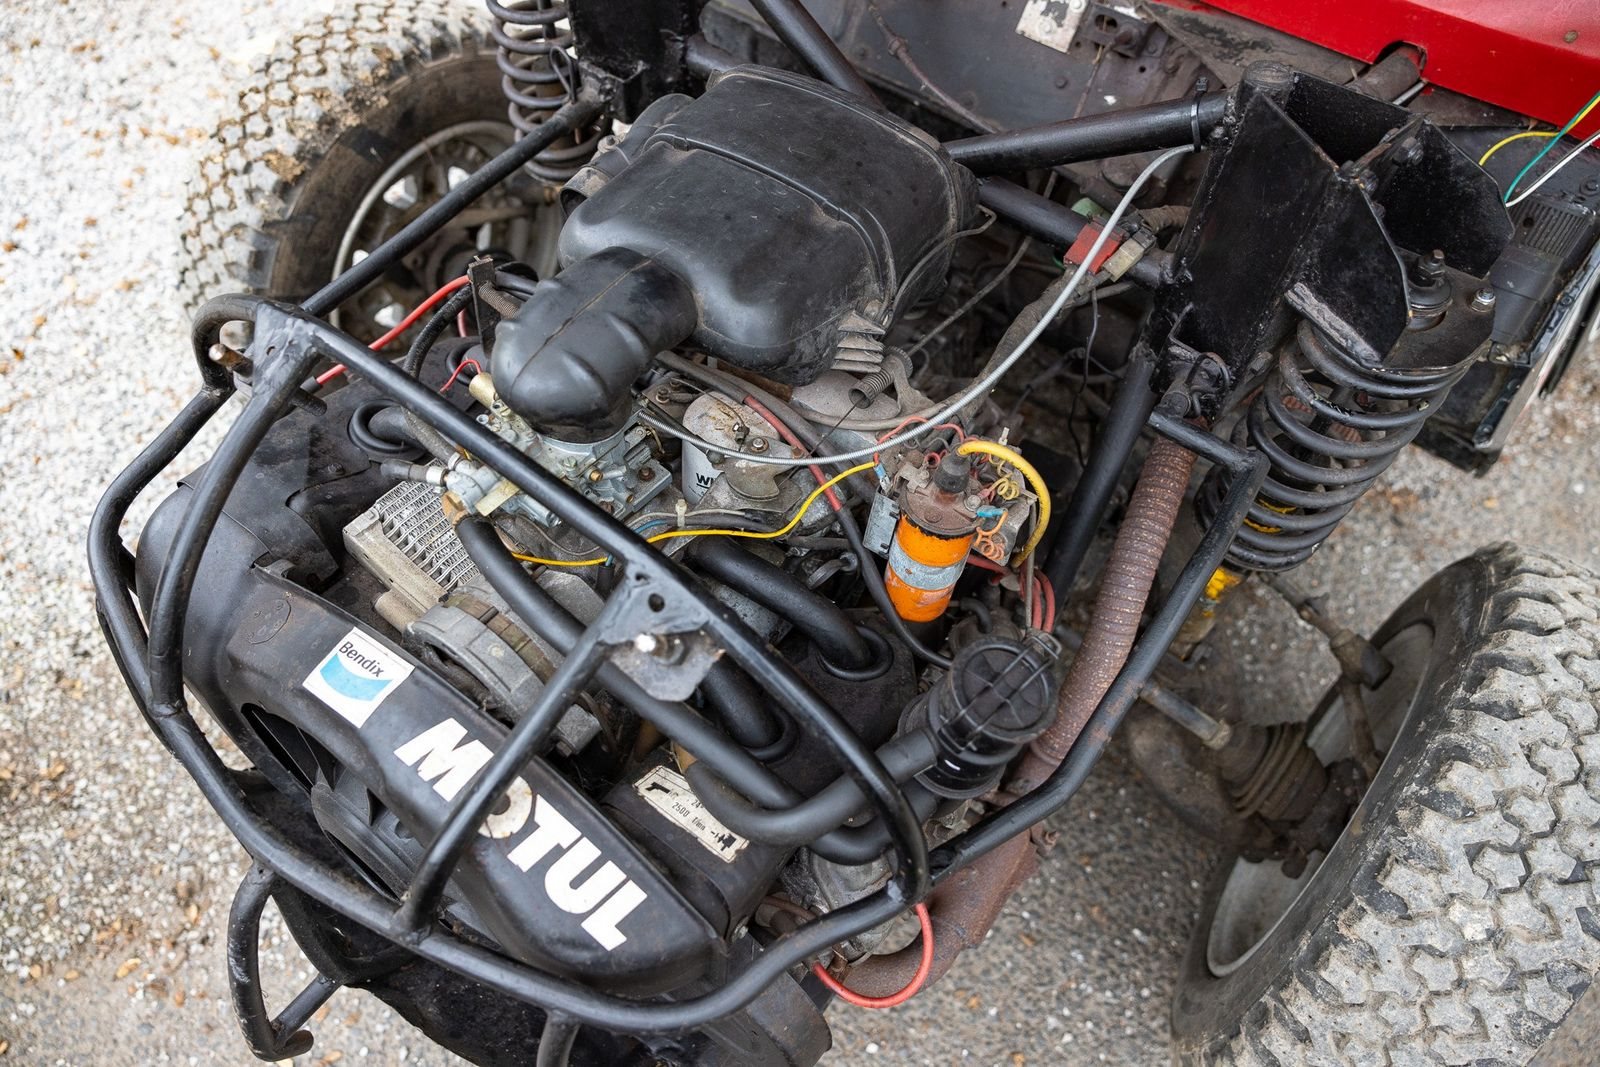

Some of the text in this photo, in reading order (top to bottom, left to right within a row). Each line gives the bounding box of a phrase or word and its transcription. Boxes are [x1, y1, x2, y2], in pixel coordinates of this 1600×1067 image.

[338, 640, 385, 678] Bendix
[671, 801, 690, 817] 2500
[393, 717, 648, 952] MOTUL
